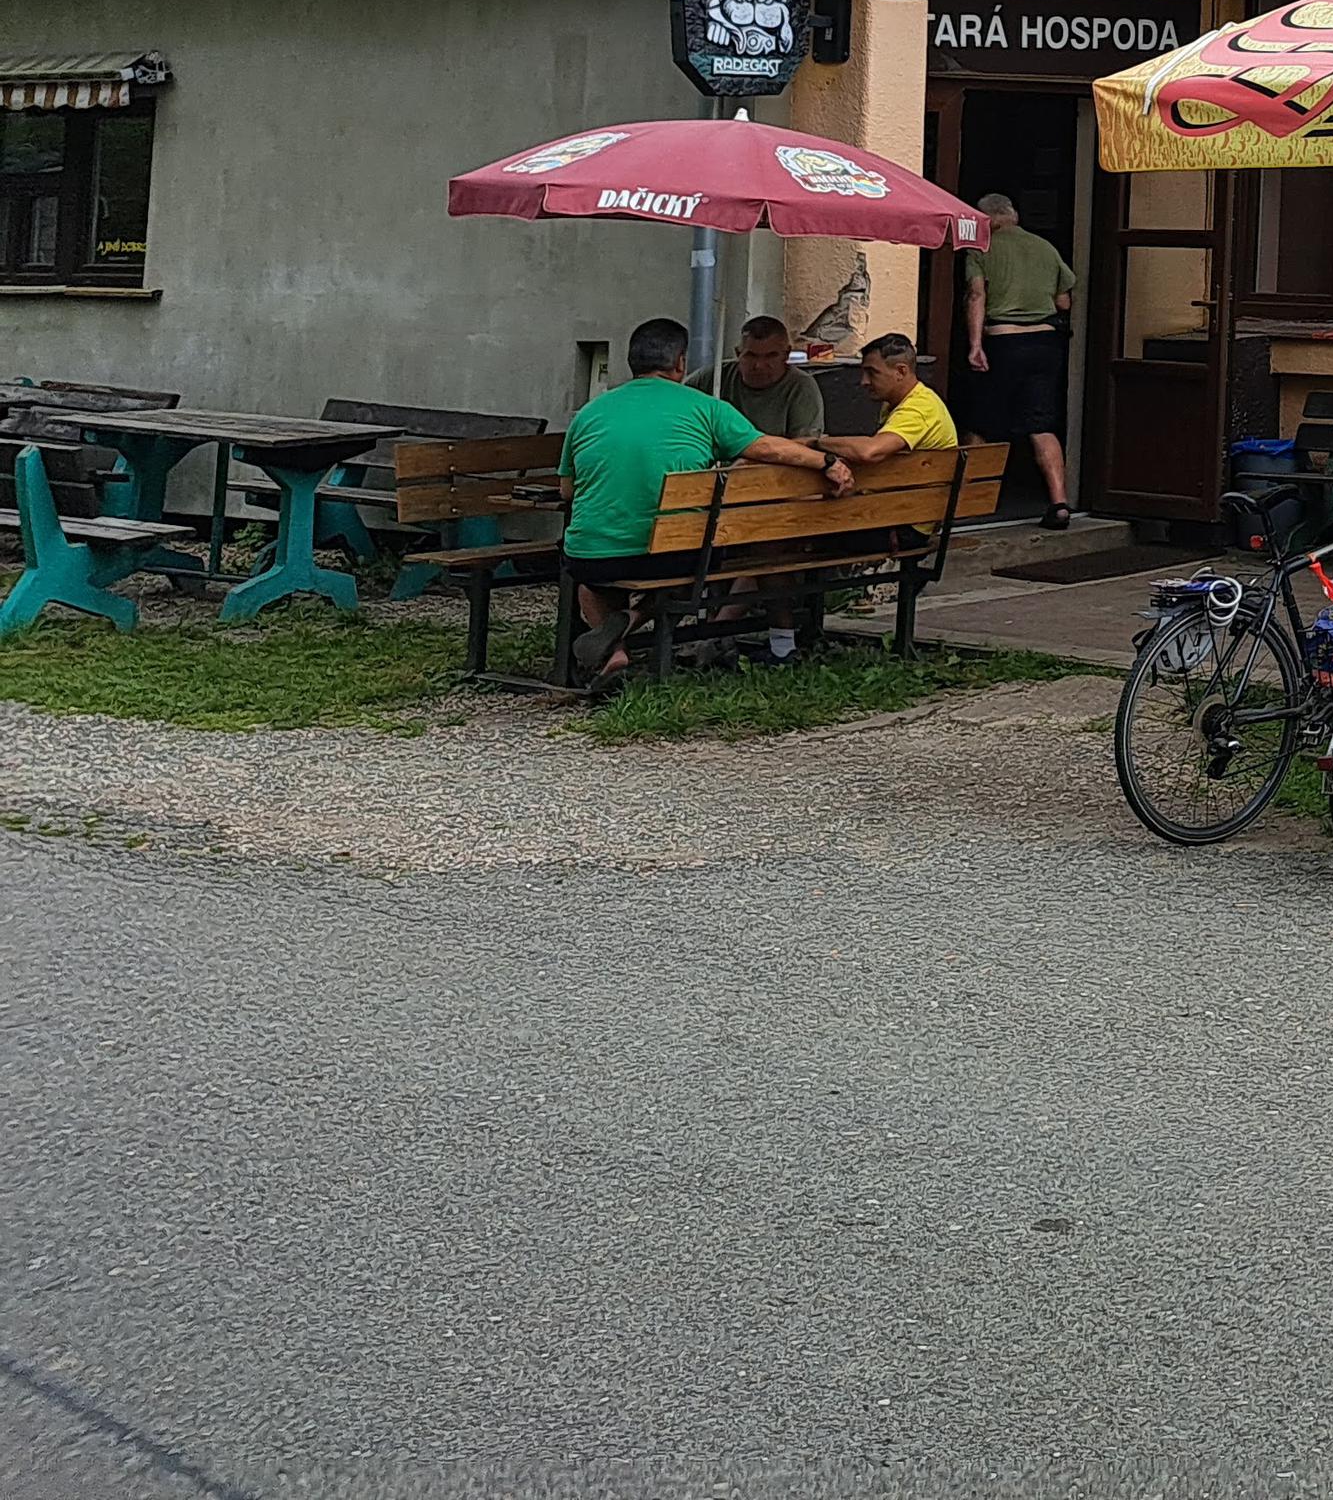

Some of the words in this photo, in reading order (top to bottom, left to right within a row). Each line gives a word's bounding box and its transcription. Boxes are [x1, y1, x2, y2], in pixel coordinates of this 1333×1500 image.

[927, 4, 1009, 49] ARÁ
[1021, 15, 1180, 51] HOSPODA
[713, 56, 783, 78] RADEGAST
[597, 187, 703, 219] DAČICKÝ
